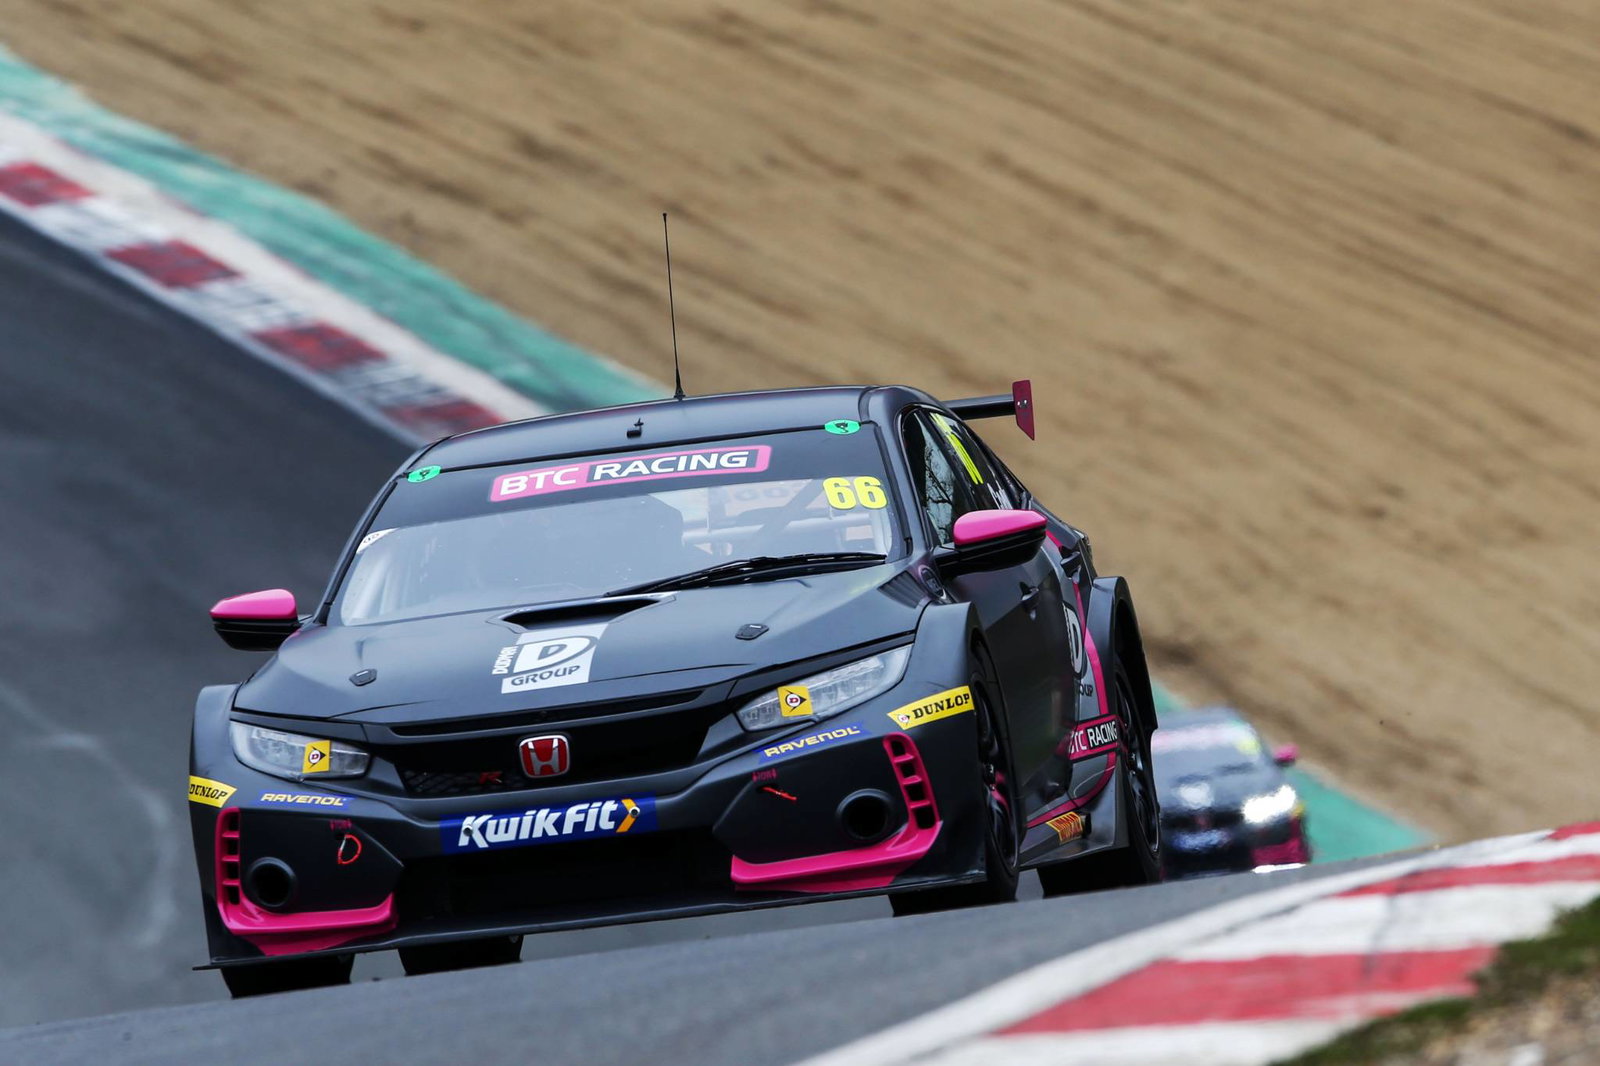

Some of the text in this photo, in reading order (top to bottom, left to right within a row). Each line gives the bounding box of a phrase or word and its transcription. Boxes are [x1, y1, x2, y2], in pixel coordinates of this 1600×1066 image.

[499, 451, 751, 496] BTC RACING
[823, 476, 888, 510] 66
[511, 665, 581, 686] GROUP
[912, 692, 970, 720] DUNLOP
[764, 727, 861, 758] RAVENOL
[1087, 721, 1118, 748] RACING
[188, 783, 228, 800] DUNLOP
[260, 793, 345, 807] RAVENOL
